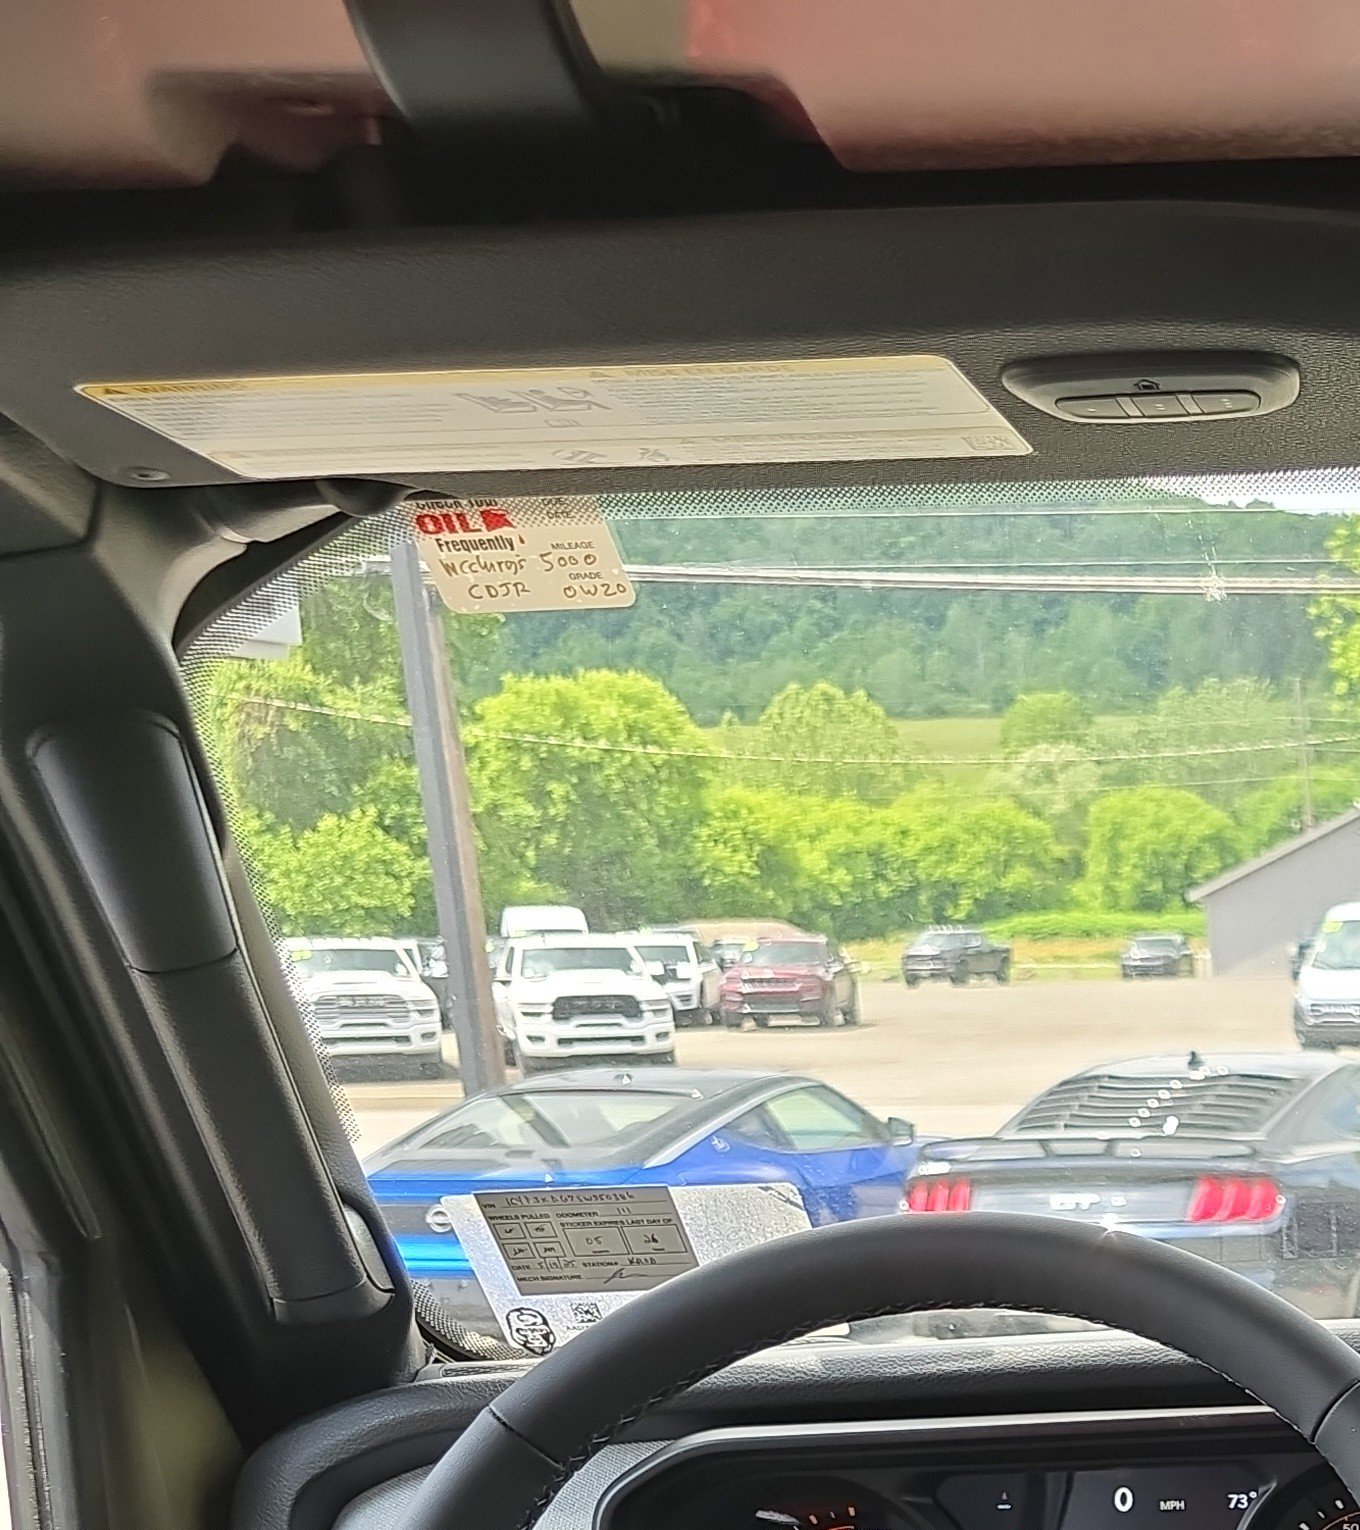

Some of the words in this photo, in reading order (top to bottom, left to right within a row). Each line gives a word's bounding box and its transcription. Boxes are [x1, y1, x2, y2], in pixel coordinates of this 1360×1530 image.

[415, 513, 483, 535] OIL
[435, 535, 514, 553] Frequently
[550, 542, 594, 550] MILEAGE
[540, 552, 597, 572] 5000
[569, 572, 603, 580] GRADE
[468, 582, 531, 599] CDJR
[1114, 1486, 1134, 1513] 0
[1159, 1500, 1185, 1511] MPH
